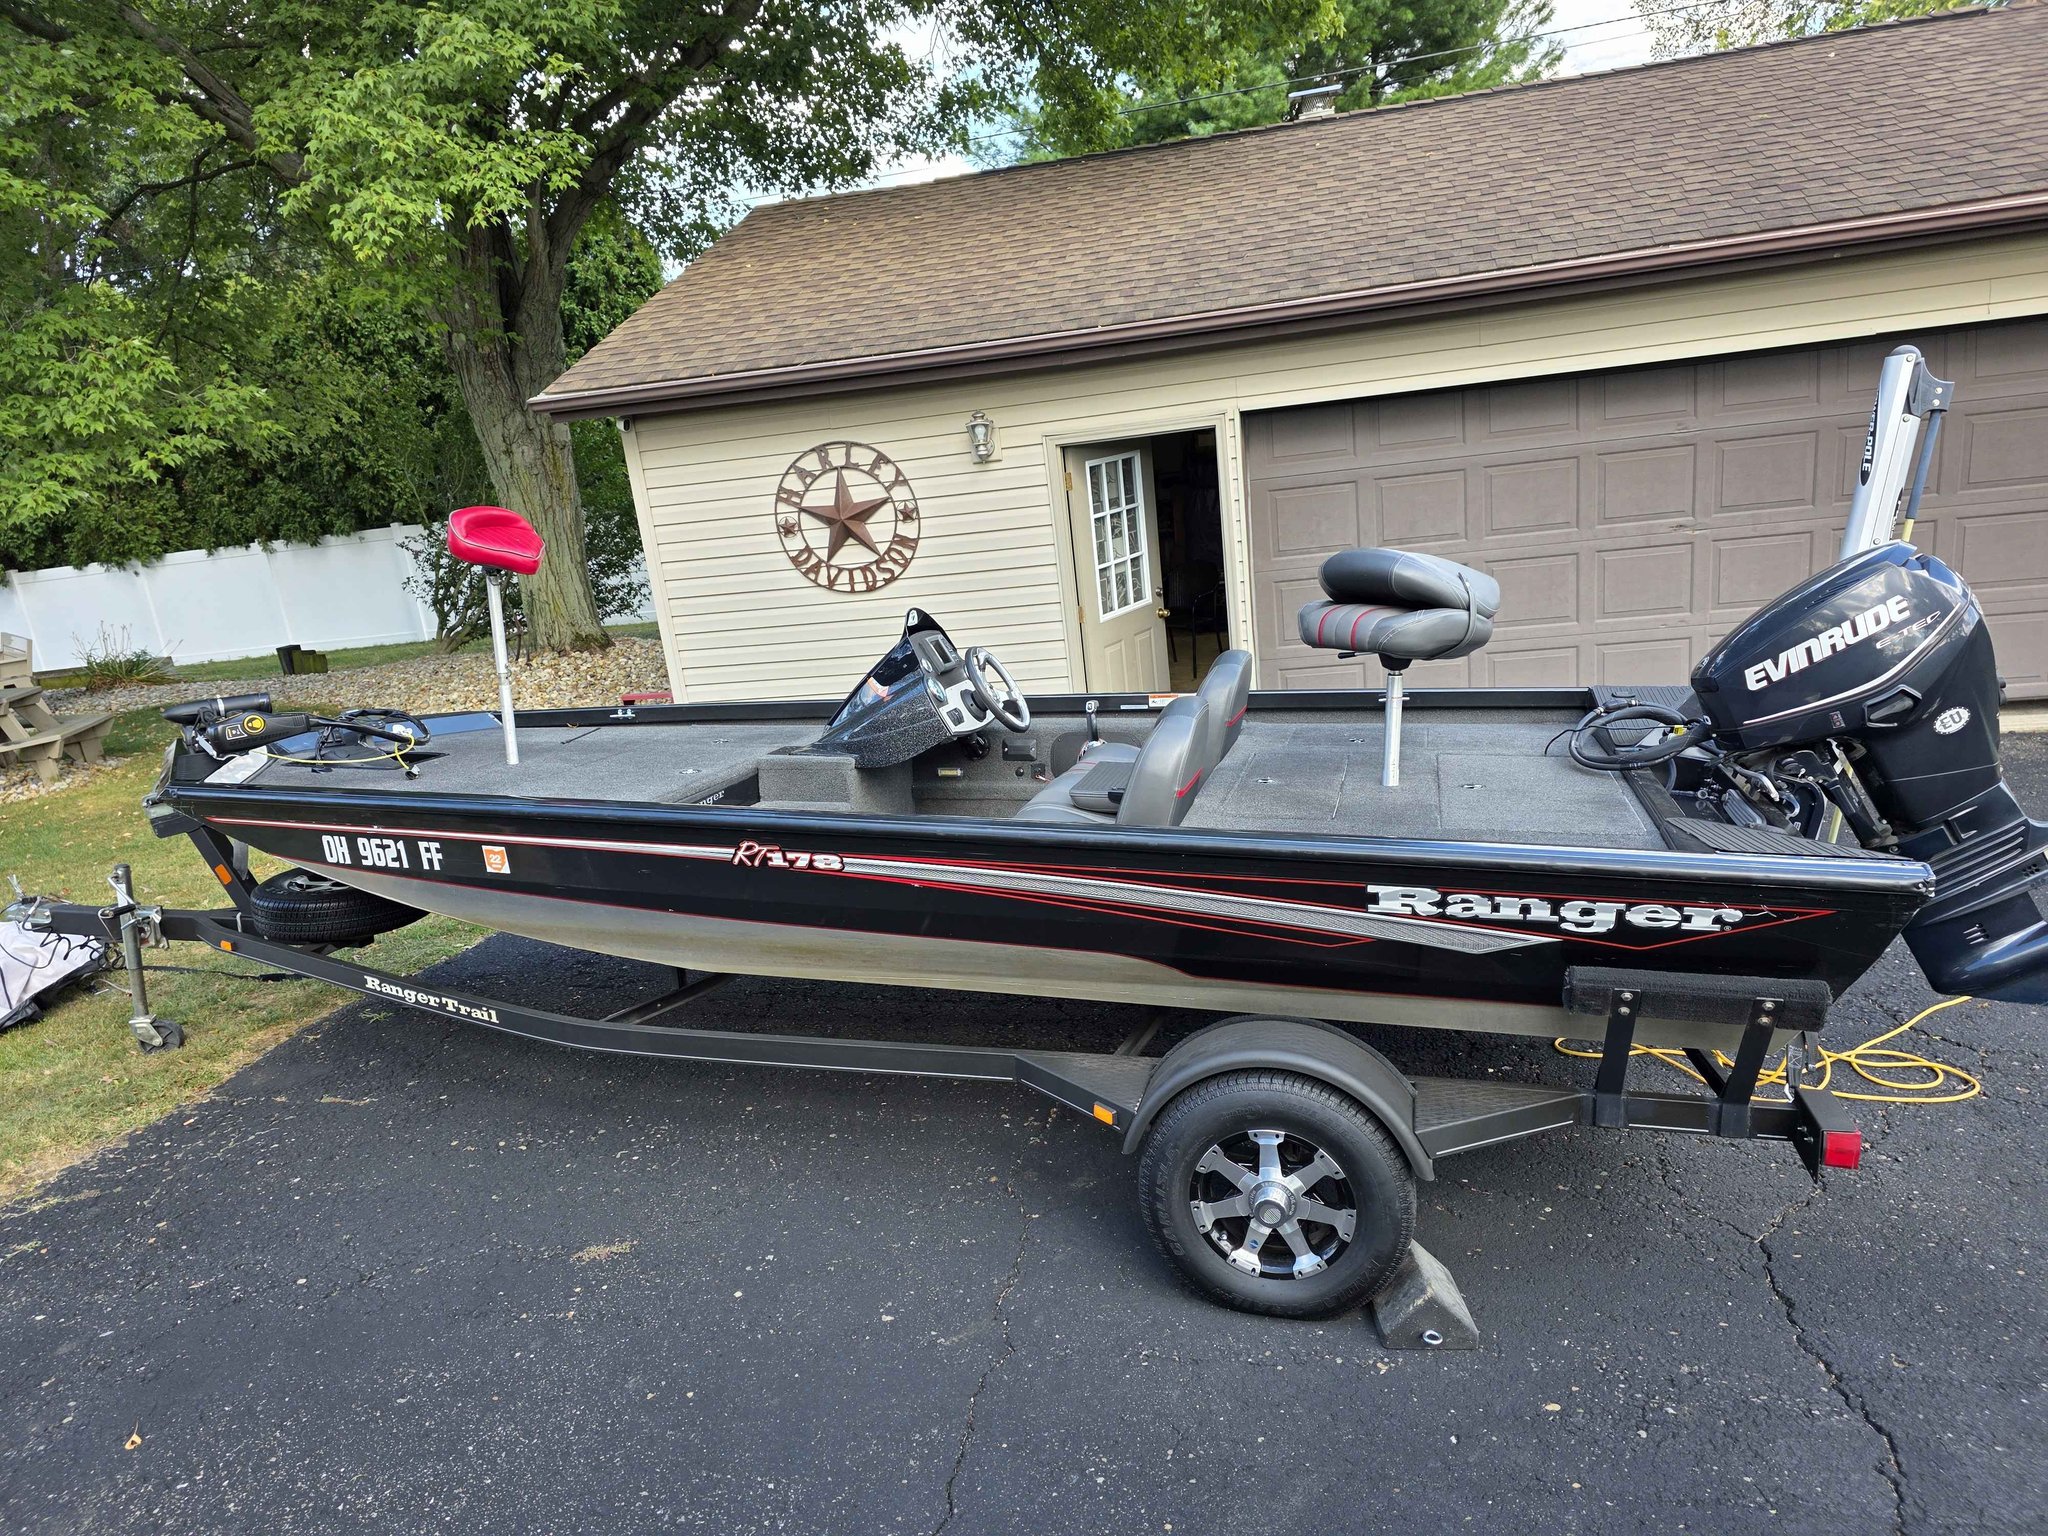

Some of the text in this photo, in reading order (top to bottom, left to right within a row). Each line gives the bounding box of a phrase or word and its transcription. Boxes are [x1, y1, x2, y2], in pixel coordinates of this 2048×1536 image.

[1862, 390, 1879, 472] WER-POLE
[776, 442, 908, 509] HARLEY
[789, 533, 919, 592] DAVIDSON
[1744, 595, 1911, 691] EVINRUDE
[1875, 610, 1941, 650] E-TEC
[697, 790, 725, 805] nger
[321, 835, 443, 870] OH 9621 FF
[1366, 884, 1744, 933] Ranger
[364, 975, 499, 1023] Ranger Trail
